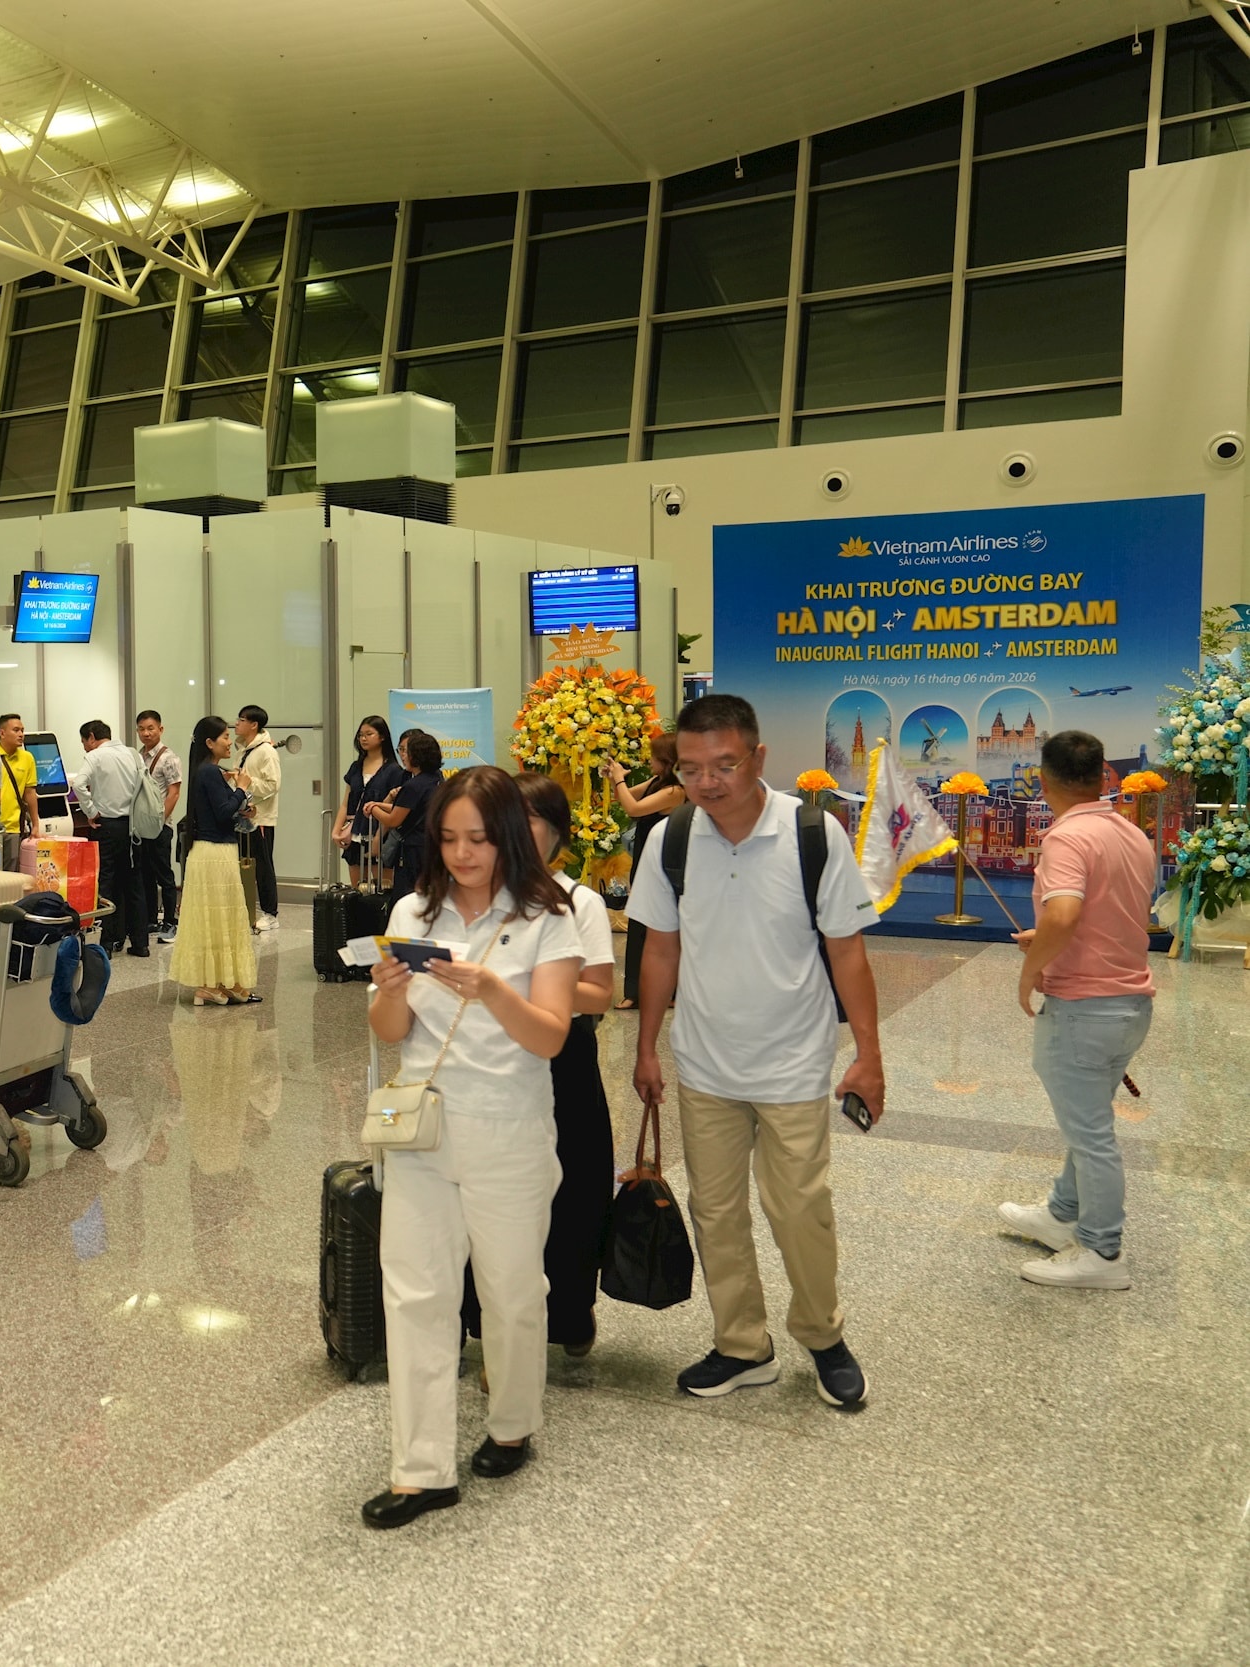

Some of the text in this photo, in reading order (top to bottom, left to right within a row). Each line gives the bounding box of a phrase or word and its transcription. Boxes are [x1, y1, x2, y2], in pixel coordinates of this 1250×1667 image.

[872, 535, 1018, 556] Vietnam Airlines
[899, 554, 991, 566] SẢI CÁNH VƯƠN CAO
[40, 580, 85, 591] Vietnam Airlines
[806, 572, 1083, 600] KHAI TRƯƠNG ĐƯỜNG BAY
[777, 599, 1117, 639] HÀ NỘI AMSTERDAM
[561, 638, 581, 646] CHÀO
[775, 638, 1117, 662] INAUGURAL FLIGHT HANOI AMSTERDAM
[843, 672, 1036, 687] Hà Nội, ngày 16 tháng 06 năm 2026
[453, 751, 471, 759] BAY
